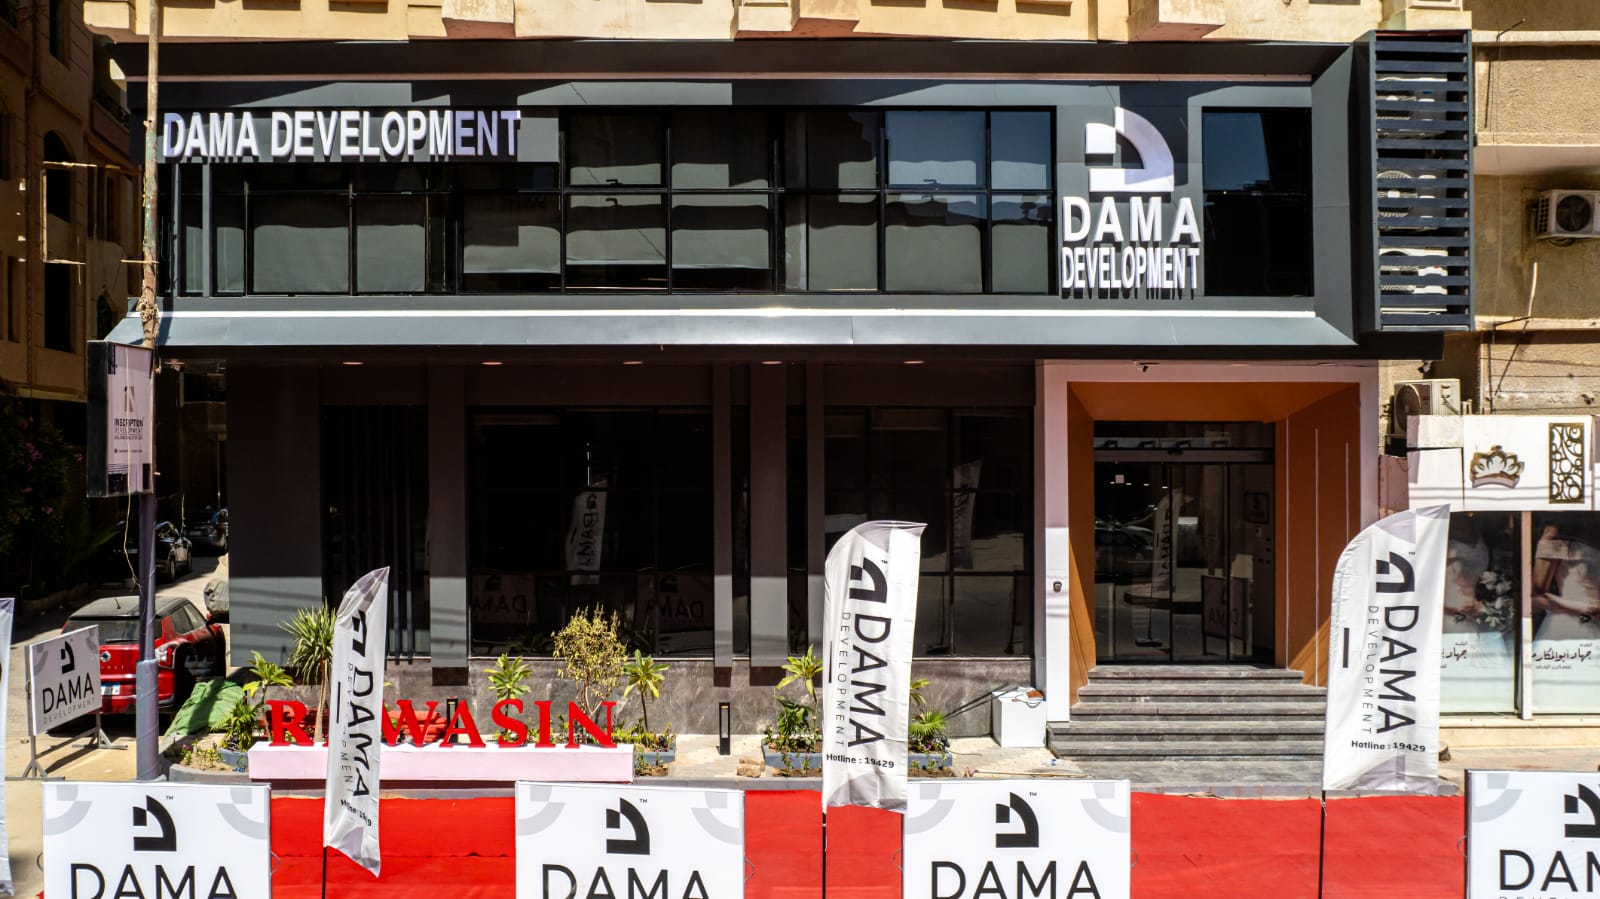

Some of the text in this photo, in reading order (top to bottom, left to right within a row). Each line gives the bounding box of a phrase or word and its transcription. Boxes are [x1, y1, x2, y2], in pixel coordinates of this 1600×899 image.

[163, 109, 521, 159] DAMA DEVELOPMENT
[1062, 195, 1201, 243] DAMA
[1061, 246, 1201, 290] DEVELOPMENT
[835, 612, 852, 746] DEVELOPMENT
[848, 613, 892, 747] DAMA
[1361, 605, 1380, 734] DEVELOPMENT
[1376, 606, 1420, 734] DAMA
[42, 671, 95, 715] DAMA
[43, 697, 96, 725] DEVELOPMENT
[266, 698, 618, 749] RWASIN
[348, 666, 375, 796] DAMA
[1351, 740, 1385, 750] Hotline
[1393, 742, 1426, 752] 19429
[826, 753, 857, 764] Hotline
[864, 757, 895, 769] 19429
[70, 863, 238, 899] DAMA
[542, 863, 710, 899] DAMA
[931, 860, 1102, 899] DAMA
